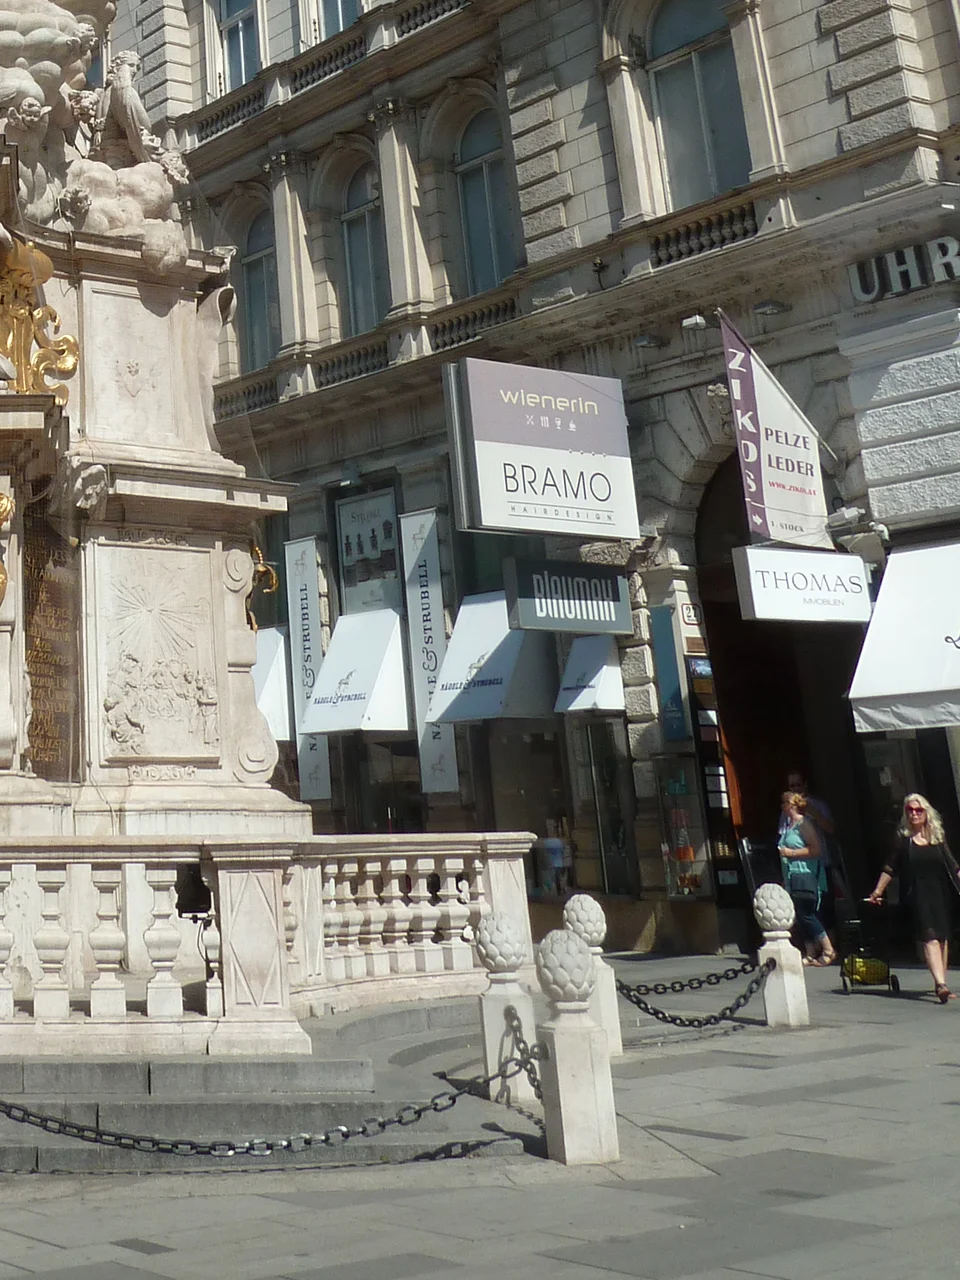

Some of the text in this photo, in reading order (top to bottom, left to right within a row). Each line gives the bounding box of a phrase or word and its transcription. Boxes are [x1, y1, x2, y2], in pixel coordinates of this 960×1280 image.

[728, 348, 759, 493] ZIKOS
[764, 426, 810, 451] PELZE
[767, 453, 815, 477] LEDER
[503, 462, 611, 502] BRAMO
[510, 505, 612, 521] HAIRDESIGN
[755, 569, 863, 594] THOMAS
[418, 559, 433, 645] STRUBELL
[300, 583, 312, 663] STRUBELL
[422, 646, 438, 672] &
[302, 664, 316, 688] &
